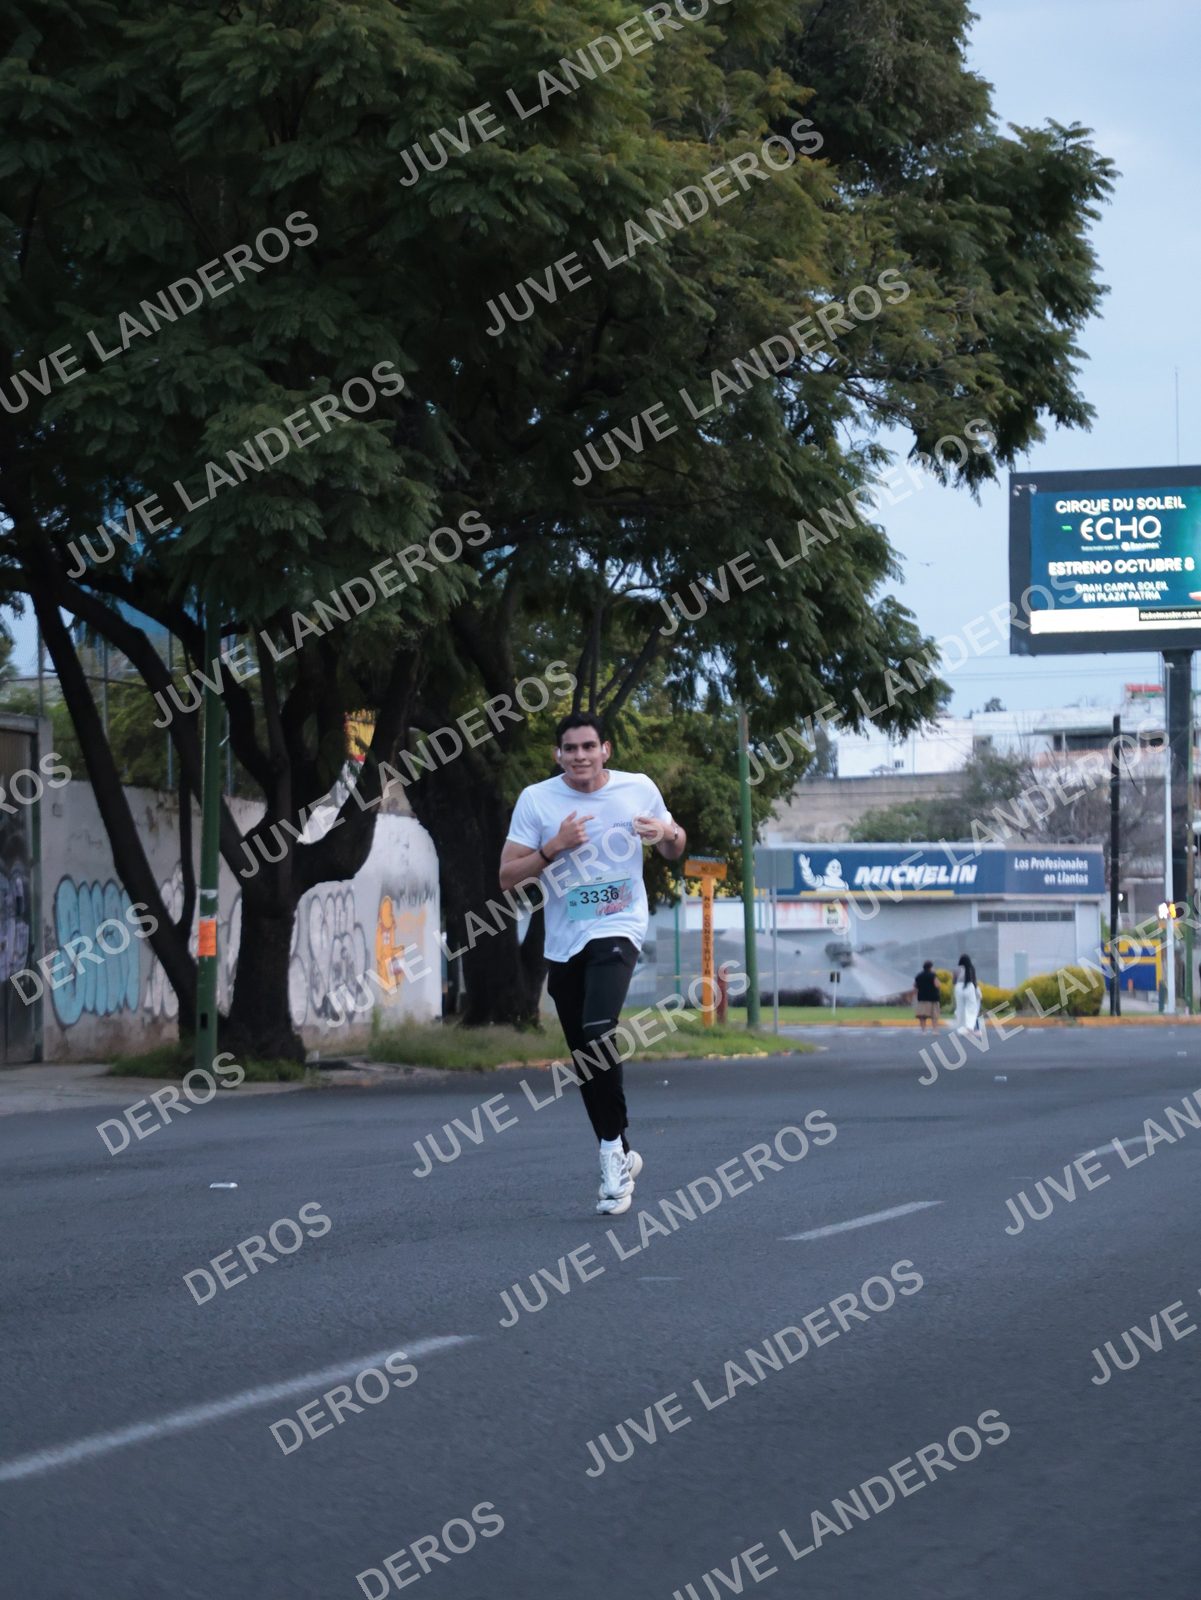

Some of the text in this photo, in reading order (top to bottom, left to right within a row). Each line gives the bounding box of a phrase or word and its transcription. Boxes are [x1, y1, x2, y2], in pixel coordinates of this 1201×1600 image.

[1055, 496, 1186, 515] CIRQUE DU SOLEIL
[1080, 515, 1162, 541] ECHO
[1048, 557, 1195, 576] ESTRENO OCTUBRE 8
[1075, 581, 1169, 593] GRAN CARPA SOLEIL
[1082, 591, 1161, 603] EN PLAZA PATRIA
[1014, 857, 1088, 870] Los Profesionales
[854, 864, 978, 885] MICHELIN
[1044, 872, 1088, 885] en Llantas
[580, 888, 619, 904] 3336
